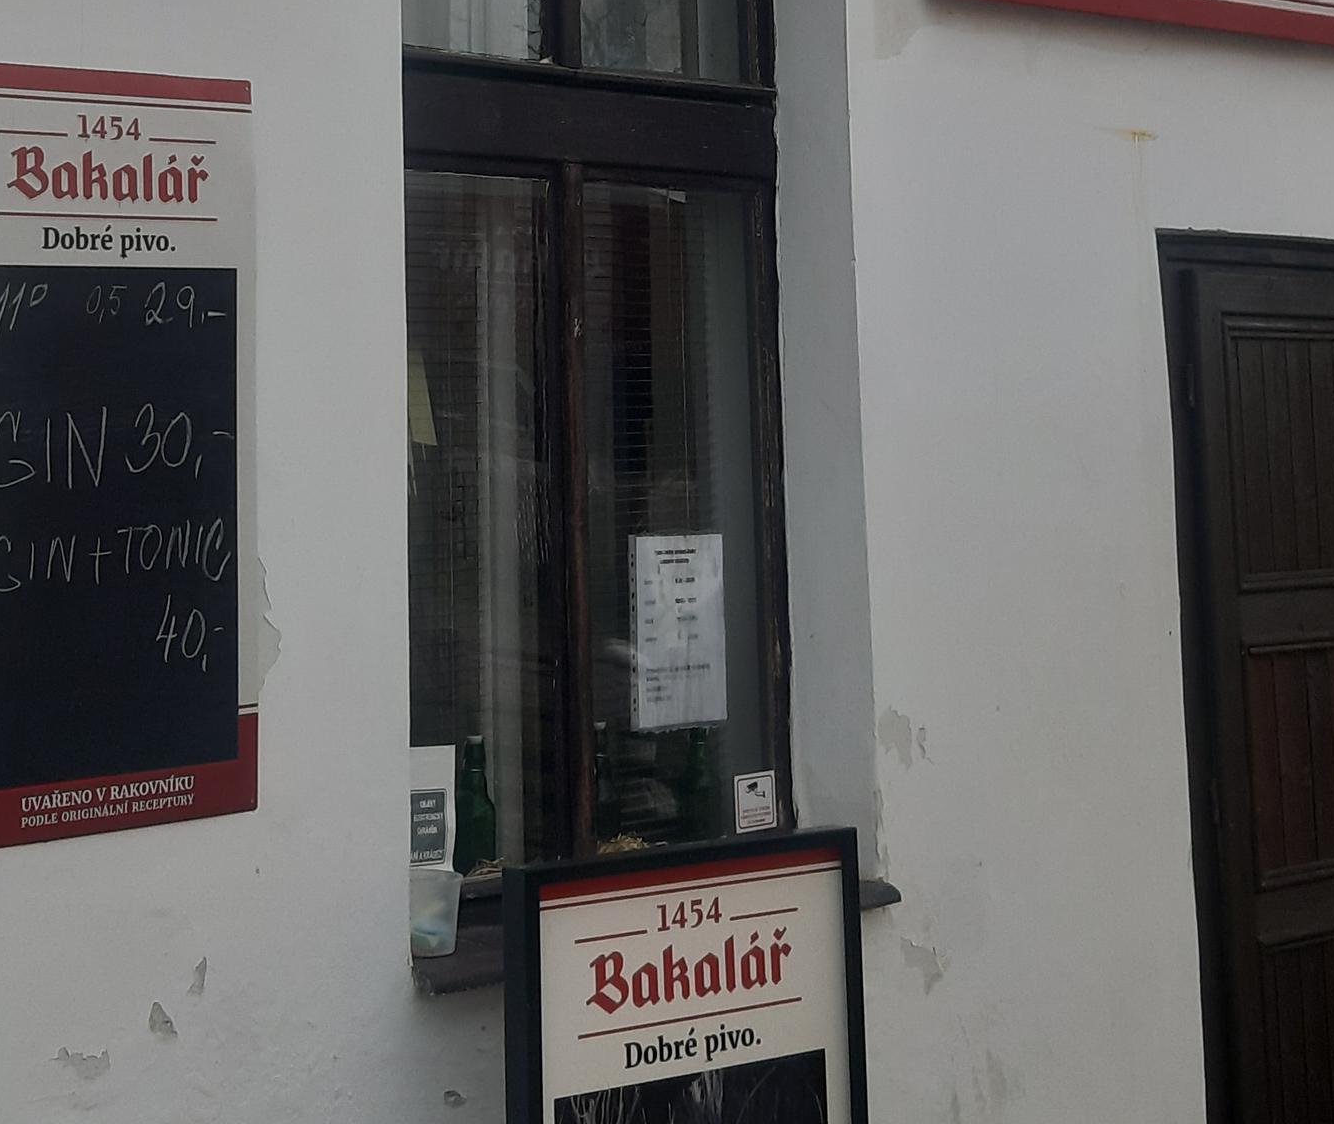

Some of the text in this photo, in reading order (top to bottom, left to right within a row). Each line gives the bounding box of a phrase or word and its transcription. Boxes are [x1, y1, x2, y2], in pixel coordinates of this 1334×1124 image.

[76, 114, 142, 144] 1454
[6, 144, 212, 206] Bakalář
[40, 225, 178, 260] Dobré pivo.
[85, 284, 128, 324] 0,5
[20, 793, 195, 829] PODLE ORIGINÁLNÍ RECEPTURY
[21, 774, 195, 813] UVAŘENO V RAKOVNÍKU
[655, 896, 723, 933] 1454
[585, 927, 793, 1015] Bakalář
[623, 1022, 763, 1070] Dobré pivo.
